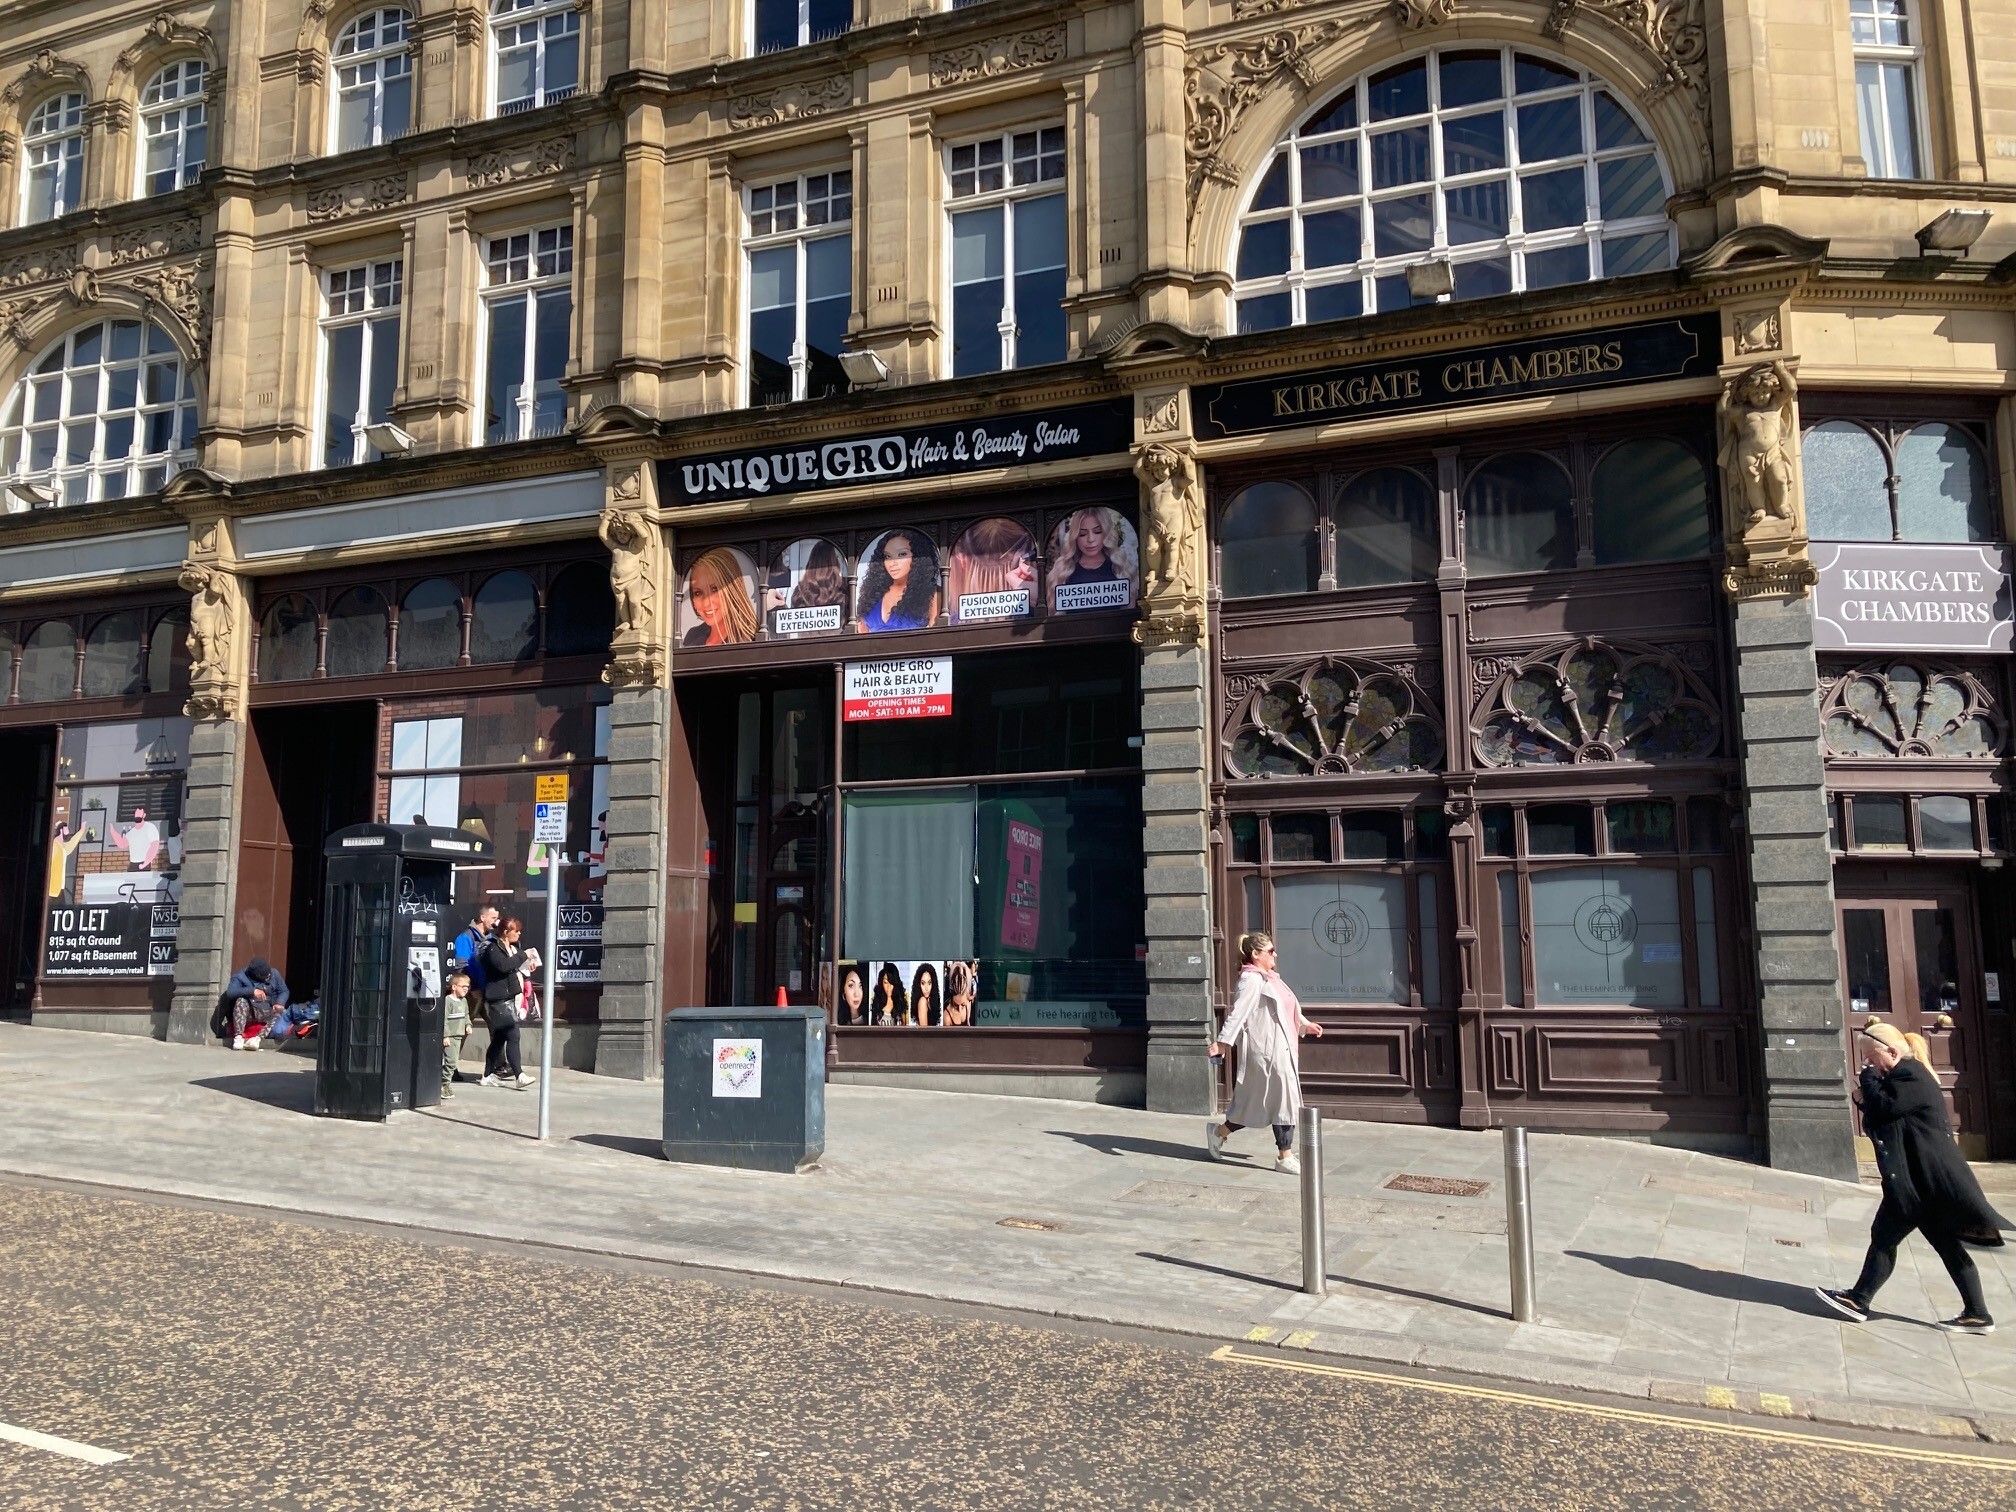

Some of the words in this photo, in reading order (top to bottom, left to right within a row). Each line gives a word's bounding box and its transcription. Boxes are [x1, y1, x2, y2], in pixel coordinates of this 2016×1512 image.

[1272, 369, 1422, 417] KIRKGATE
[1441, 341, 1623, 393] CHAMBERS
[682, 450, 819, 494] UNIQUE
[826, 440, 903, 478] GRO
[909, 436, 949, 469] Hair
[952, 430, 970, 461] &
[971, 428, 1028, 461] Beauty
[1033, 421, 1081, 454] Salon
[1842, 569, 1984, 592] KIRKGATE
[1057, 584, 1102, 598] RUSSIAN
[1103, 582, 1128, 594] HAIR
[961, 594, 998, 607] FUSION
[999, 592, 1028, 604] BOND
[1061, 594, 1124, 608] EXTENSIONS
[779, 612, 793, 621] WE
[794, 610, 815, 620] SELL
[816, 608, 838, 618] HAIR
[964, 604, 1024, 618] EXTENSIONS
[1840, 599, 1990, 624] CHAMBERS
[780, 618, 836, 631] EXTENSIONS
[860, 661, 906, 675] UNIQUE
[908, 659, 934, 671] GRO
[853, 676, 881, 688] HAIR
[883, 675, 892, 686] &
[894, 672, 941, 685] BEAUTY
[860, 689, 872, 698] M:
[872, 688, 898, 697] 07841
[900, 687, 916, 696] 383
[918, 686, 934, 694] 738
[867, 698, 902, 708] OPENING
[903, 697, 927, 706] TIMES
[848, 709, 870, 719] MON
[875, 708, 893, 717] SAT:
[895, 707, 905, 716] 10
[906, 706, 920, 715] AM
[926, 704, 946, 714] 7PM
[52, 909, 75, 932] TO
[79, 909, 109, 931] LET
[153, 905, 179, 922] wsb
[560, 905, 592, 924] wsb
[49, 935, 65, 947] 815
[66, 938, 77, 948] sq
[78, 935, 86, 945] ft
[87, 935, 122, 946] Ground
[48, 950, 70, 963] 1,077
[71, 951, 82, 963] sq
[83, 950, 91, 960] ft
[92, 950, 138, 960] Basement
[152, 945, 171, 961] SW
[560, 949, 583, 966] SW
[46, 966, 144, 976] www.theleemingbuilding.com/retail
[1580, 985, 1616, 993] LEEMING
[1037, 1009, 1058, 1020] Free
[1059, 1009, 1097, 1022] hearing
[719, 1062, 755, 1070] openreach
